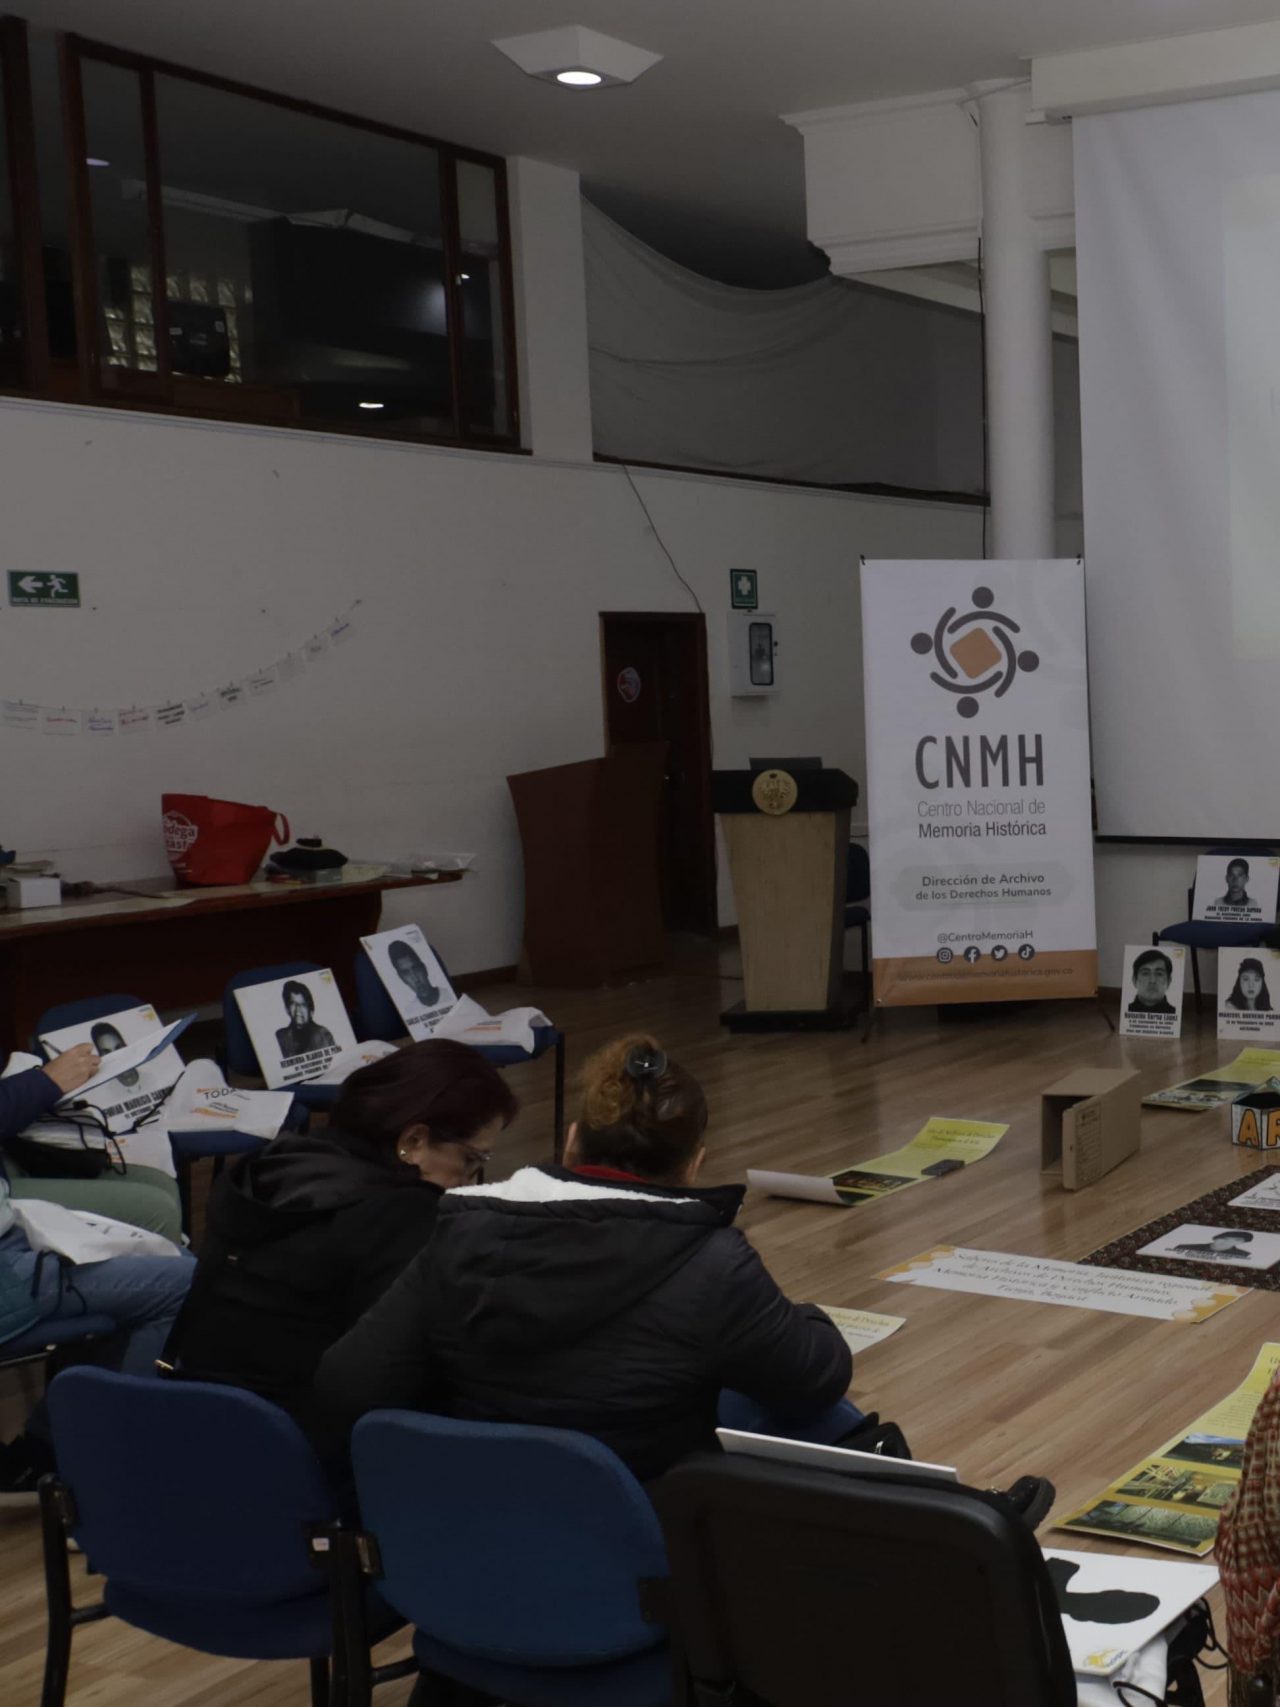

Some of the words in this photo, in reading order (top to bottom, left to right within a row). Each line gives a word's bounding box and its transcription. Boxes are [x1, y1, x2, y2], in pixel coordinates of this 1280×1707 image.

[915, 733, 1044, 790] CNMH
[917, 800, 963, 818] Centro
[966, 799, 1024, 817] Nacional
[1028, 799, 1046, 815] de
[918, 821, 982, 839] Memoria
[985, 820, 1047, 837] Histórica
[921, 874, 978, 887] Dirección
[981, 874, 997, 885] de
[999, 872, 1045, 885] Archivo
[915, 891, 929, 901] de
[931, 890, 947, 900] los
[949, 888, 999, 899] Derechos
[1001, 887, 1052, 898] Humanos
[936, 929, 1034, 944] @CentroMemoriaH
